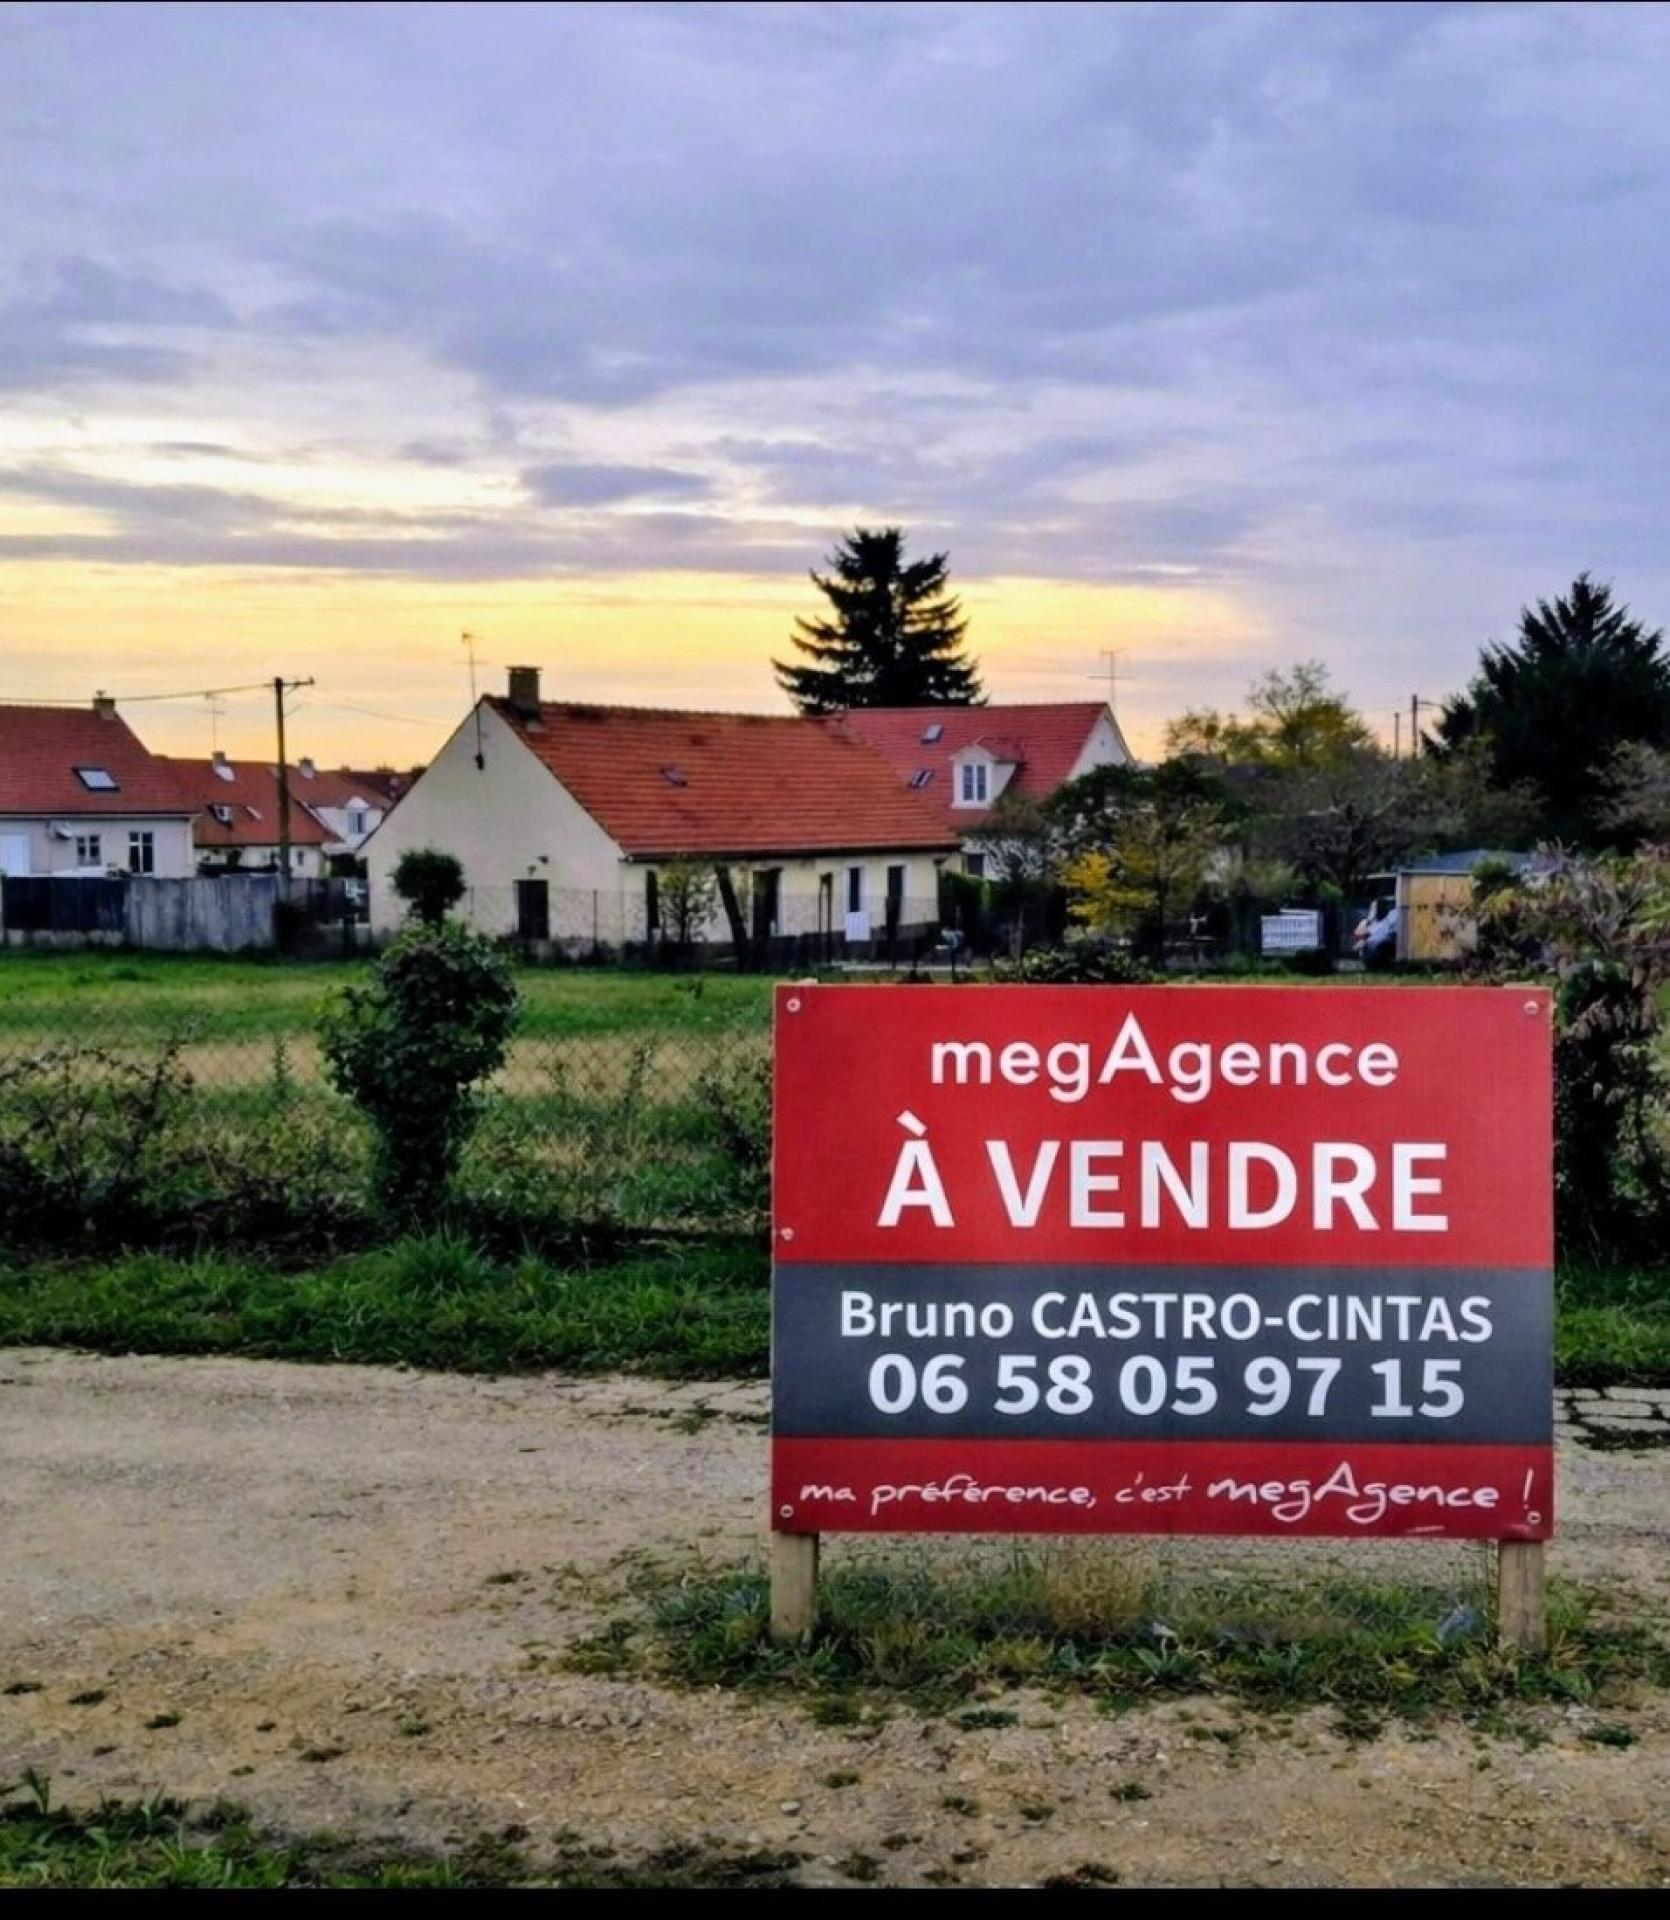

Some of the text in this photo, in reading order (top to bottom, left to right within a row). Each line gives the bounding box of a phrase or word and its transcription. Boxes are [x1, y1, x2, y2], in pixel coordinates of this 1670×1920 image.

[931, 1011, 1400, 1104] megAgence
[876, 1110, 1450, 1232] À VENDRE
[840, 1289, 1494, 1344] Bruno CASTRO-CINTAS
[868, 1352, 1466, 1419] 06 58 05 97 15
[799, 1483, 856, 1502] ma
[869, 1472, 1098, 1514] préférence,
[1207, 1461, 1499, 1525] megAgence
[1522, 1467, 1534, 1511] !
